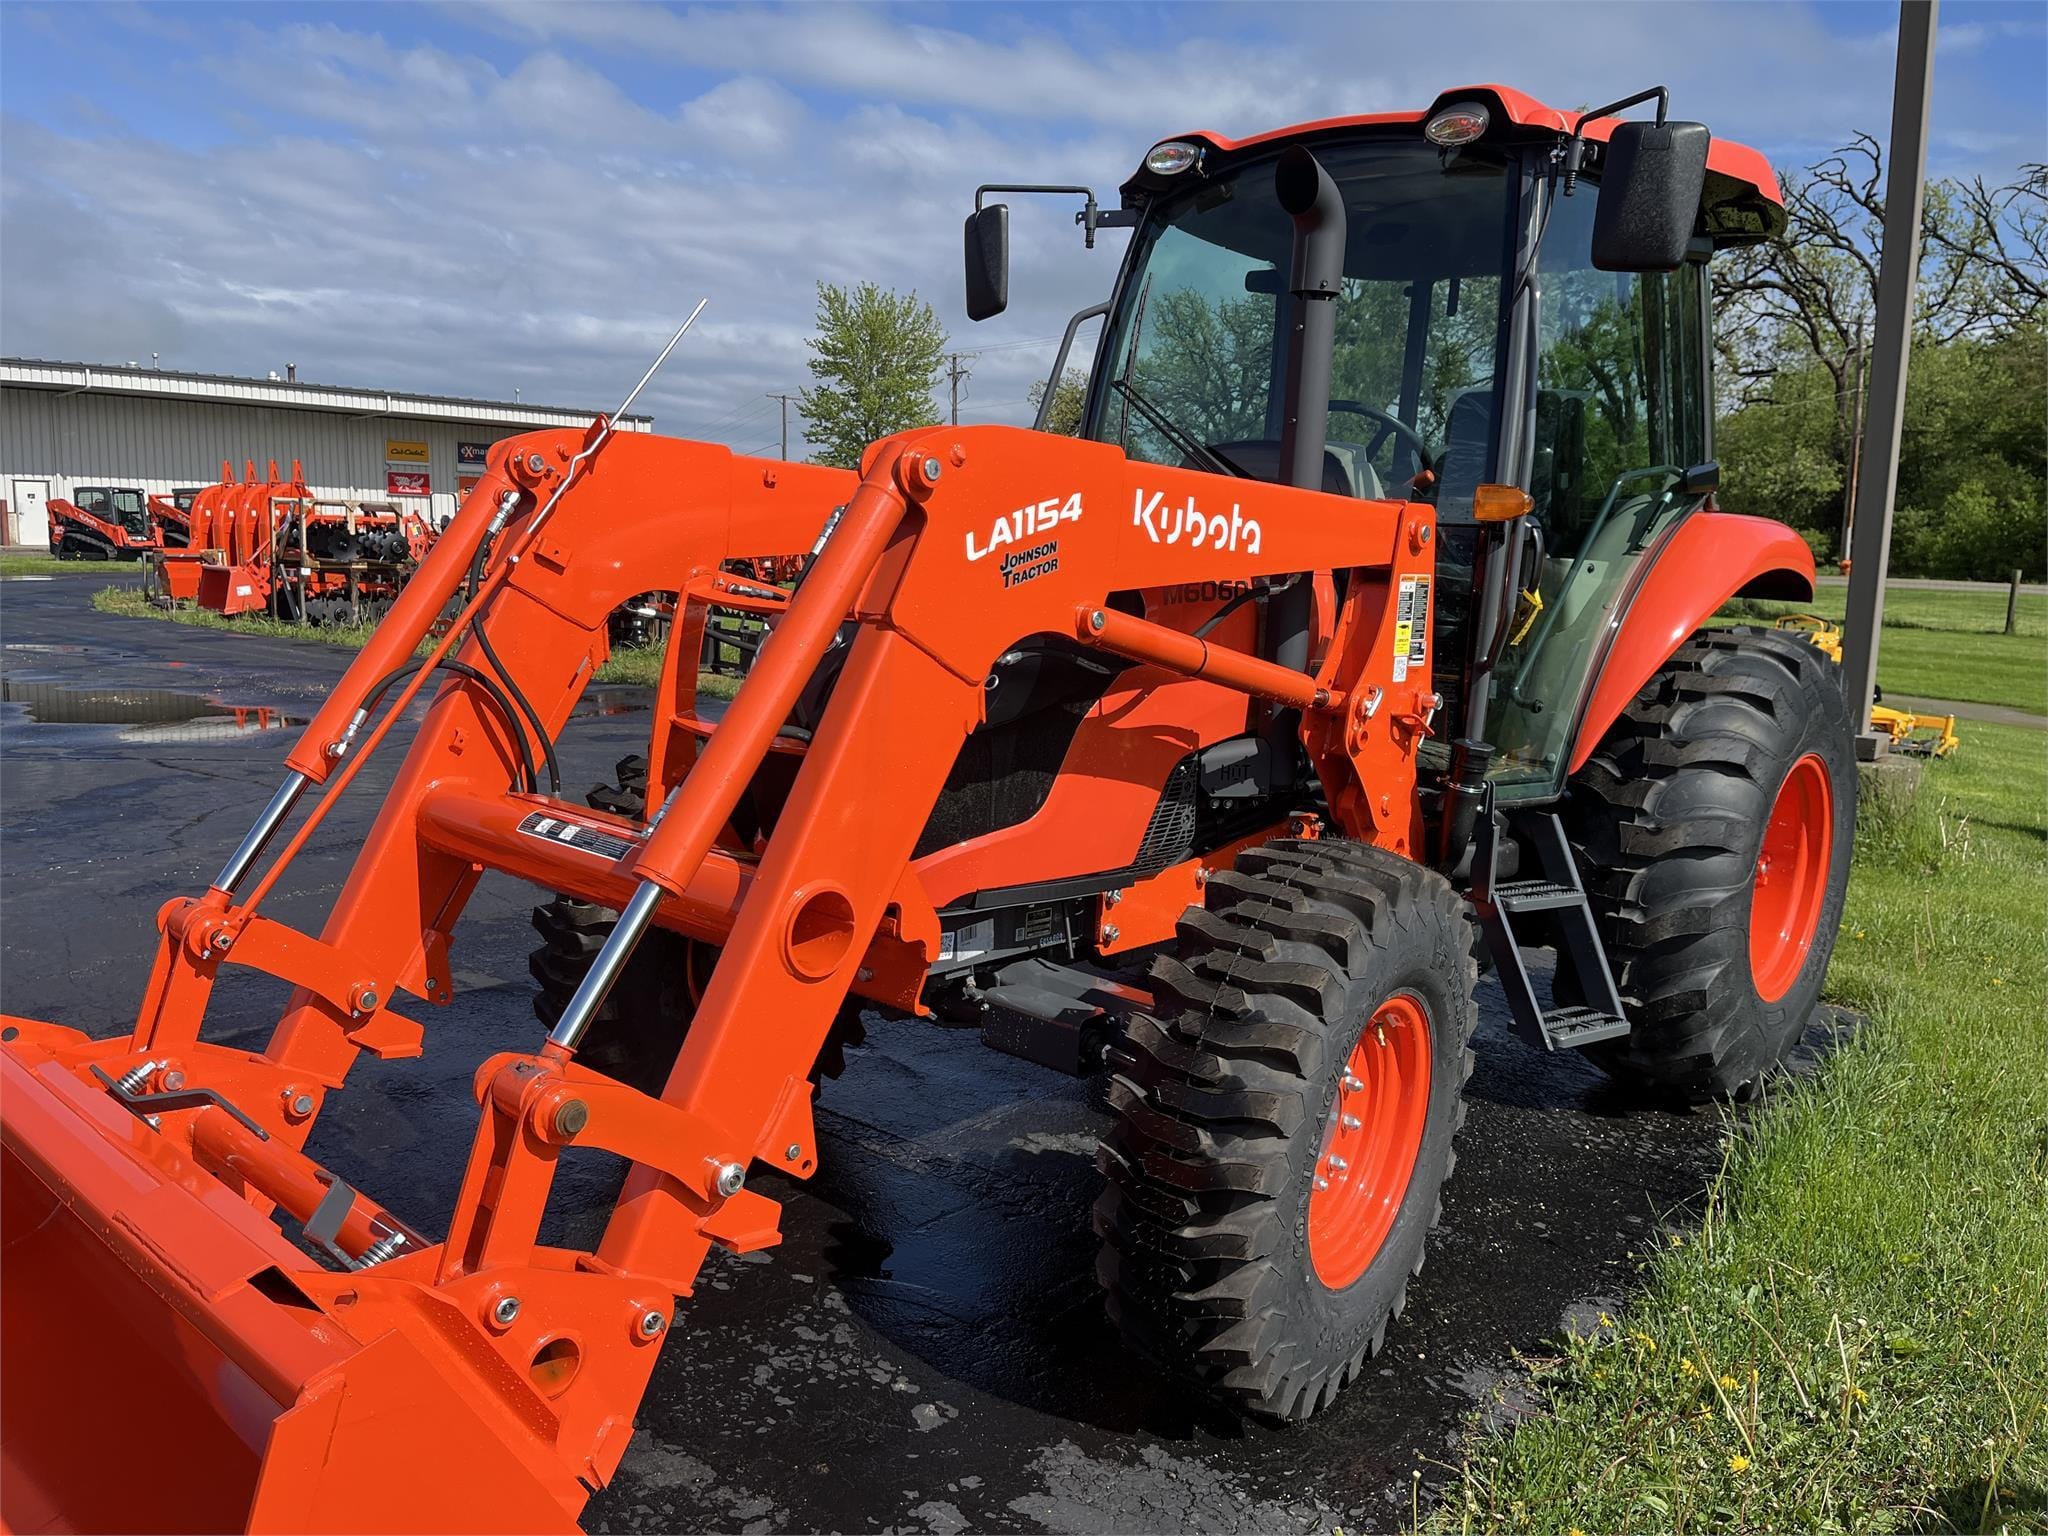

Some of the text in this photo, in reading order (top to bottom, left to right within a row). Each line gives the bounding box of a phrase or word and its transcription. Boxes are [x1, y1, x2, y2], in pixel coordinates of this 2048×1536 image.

[965, 493, 1082, 561] LA1154
[1133, 488, 1261, 555] Kubota
[1000, 541, 1057, 571] JOHNSON
[1002, 557, 1058, 588] TRACTOR
[1220, 763, 1251, 781] HOT
